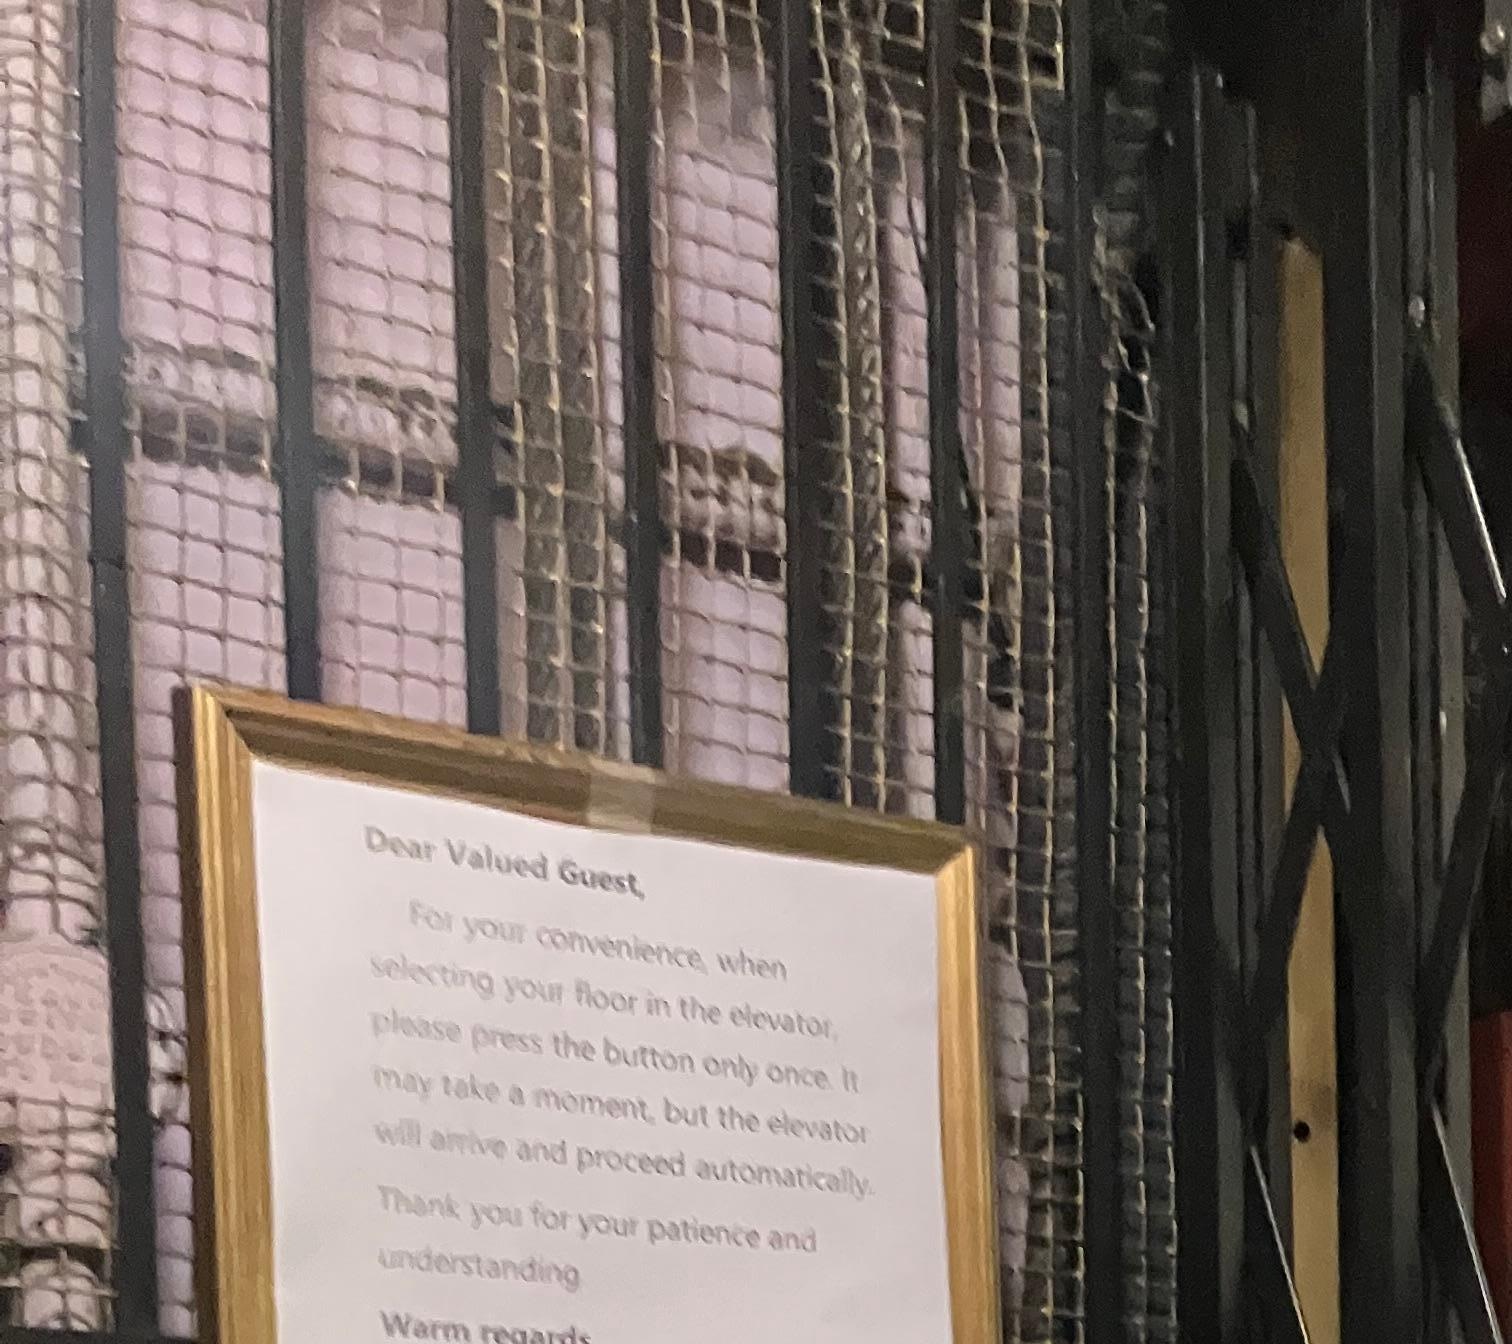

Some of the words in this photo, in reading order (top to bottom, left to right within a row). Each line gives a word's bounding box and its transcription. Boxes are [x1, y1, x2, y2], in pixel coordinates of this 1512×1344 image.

[364, 824, 437, 862] Dear
[446, 838, 549, 881] Valued
[559, 857, 645, 901] Guest,
[410, 899, 453, 932] For
[464, 916, 527, 944] your
[536, 924, 708, 976] convenience,
[717, 949, 788, 981] when
[370, 953, 495, 1000] selecting
[503, 975, 563, 1003] your
[575, 978, 638, 1015] floor
[647, 989, 671, 1018] in
[680, 996, 722, 1025] the
[369, 1007, 462, 1043] please
[471, 1023, 543, 1054] press
[553, 1031, 596, 1061] the
[603, 1037, 695, 1073] button
[702, 1053, 760, 1087] only
[842, 1065, 859, 1093] It
[373, 1065, 431, 1104] may
[442, 1073, 500, 1104] take
[509, 1084, 525, 1106] a
[533, 1087, 655, 1126] moment,
[664, 1097, 710, 1128] but
[718, 1105, 760, 1133] the
[767, 1110, 868, 1144] elevator
[374, 1118, 421, 1146] will
[430, 1130, 508, 1160] arrive
[516, 1139, 567, 1165] and
[577, 1145, 685, 1177] proceed
[696, 1158, 874, 1201] automatically.
[377, 1184, 461, 1221] Thank
[471, 1202, 522, 1230] you
[529, 1200, 569, 1230] for
[578, 1213, 639, 1240] your
[647, 1216, 761, 1249] patience
[767, 1227, 816, 1252] and
[378, 1245, 579, 1294] understanding
[380, 1309, 471, 1344] Warm
